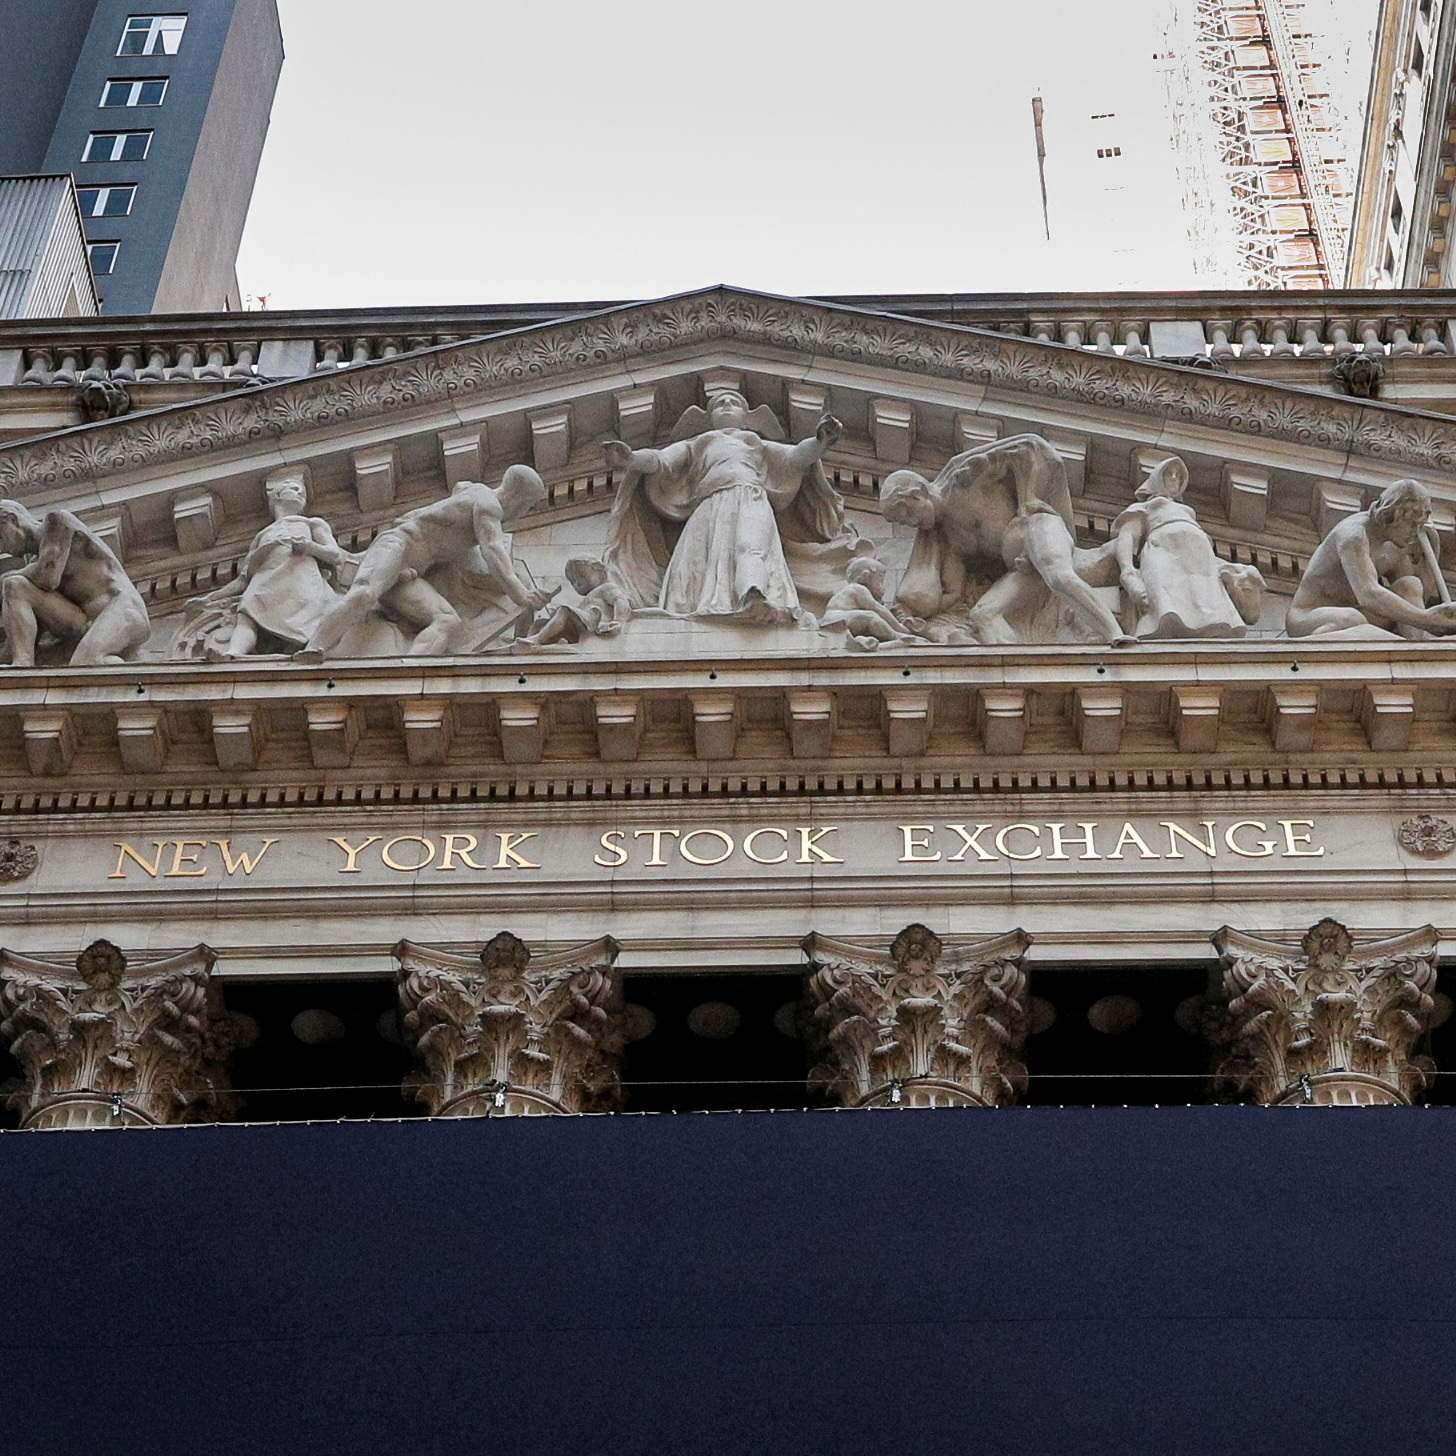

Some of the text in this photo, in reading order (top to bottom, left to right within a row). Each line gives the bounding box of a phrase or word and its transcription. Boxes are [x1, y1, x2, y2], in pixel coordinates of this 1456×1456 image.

[107, 818, 1326, 879] NEW YORK STOCK EXCHANGE
